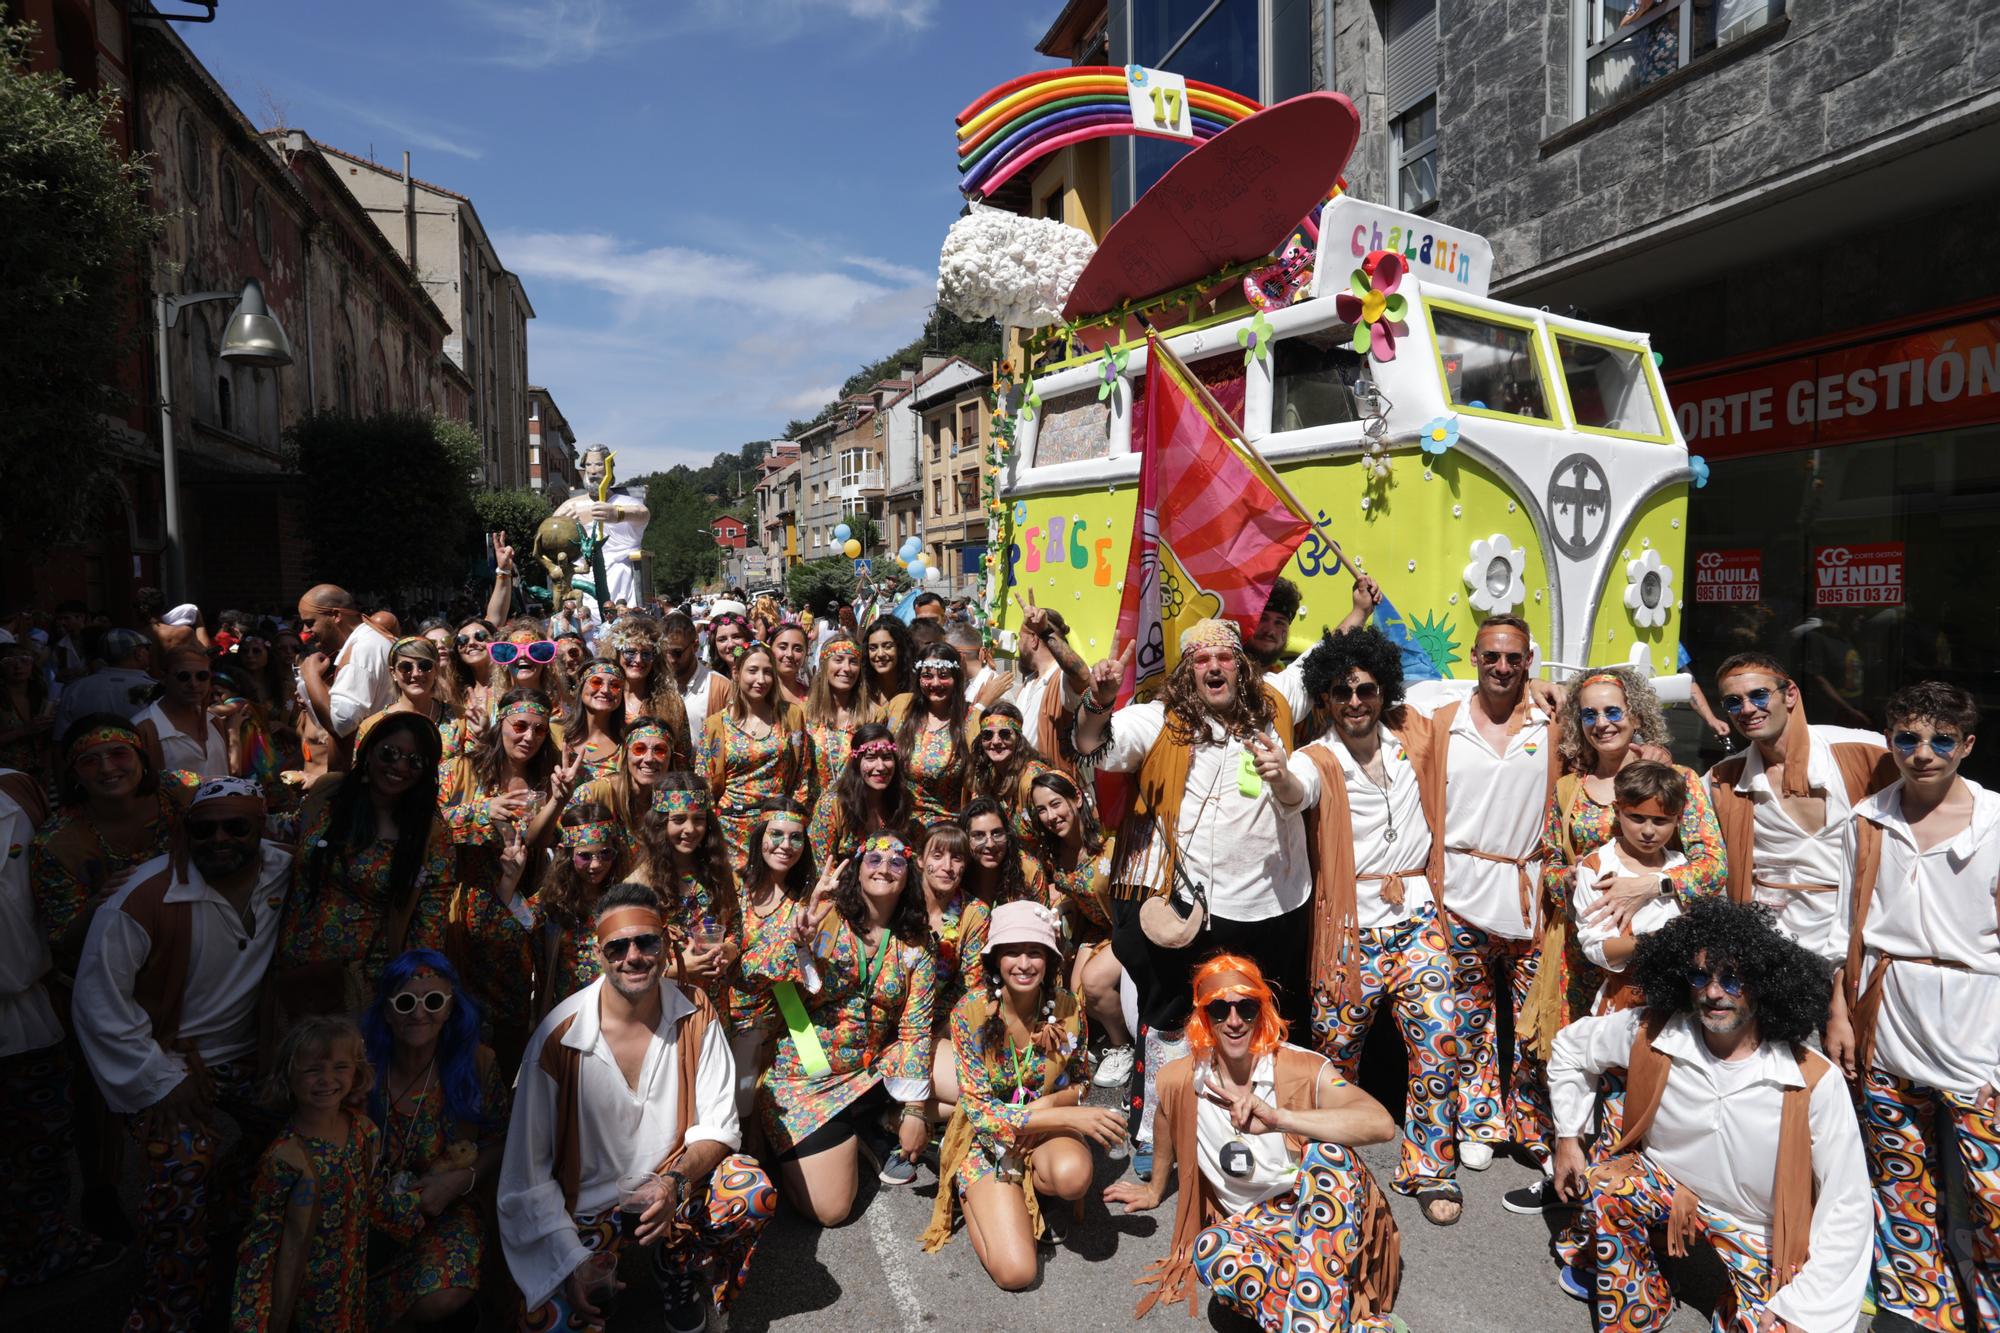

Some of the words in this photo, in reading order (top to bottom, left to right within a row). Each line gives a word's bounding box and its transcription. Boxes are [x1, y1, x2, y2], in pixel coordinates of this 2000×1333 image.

[1149, 86, 1181, 125] 17
[1676, 387, 1774, 442] ORTE
[1786, 338, 2000, 426] GESTIÓN
[1007, 516, 1113, 587] PEACE
[1697, 567, 1760, 584] ALQUILA
[1817, 564, 1902, 587] VENDE
[1697, 586, 1714, 600] 985
[1717, 585, 1728, 600] 61
[1731, 585, 1743, 600] 03
[1745, 585, 1758, 600] 27
[1818, 588, 1843, 602] 985
[1846, 588, 1861, 602] 61
[1864, 587, 1880, 602] 03
[1884, 587, 1900, 601] 27
